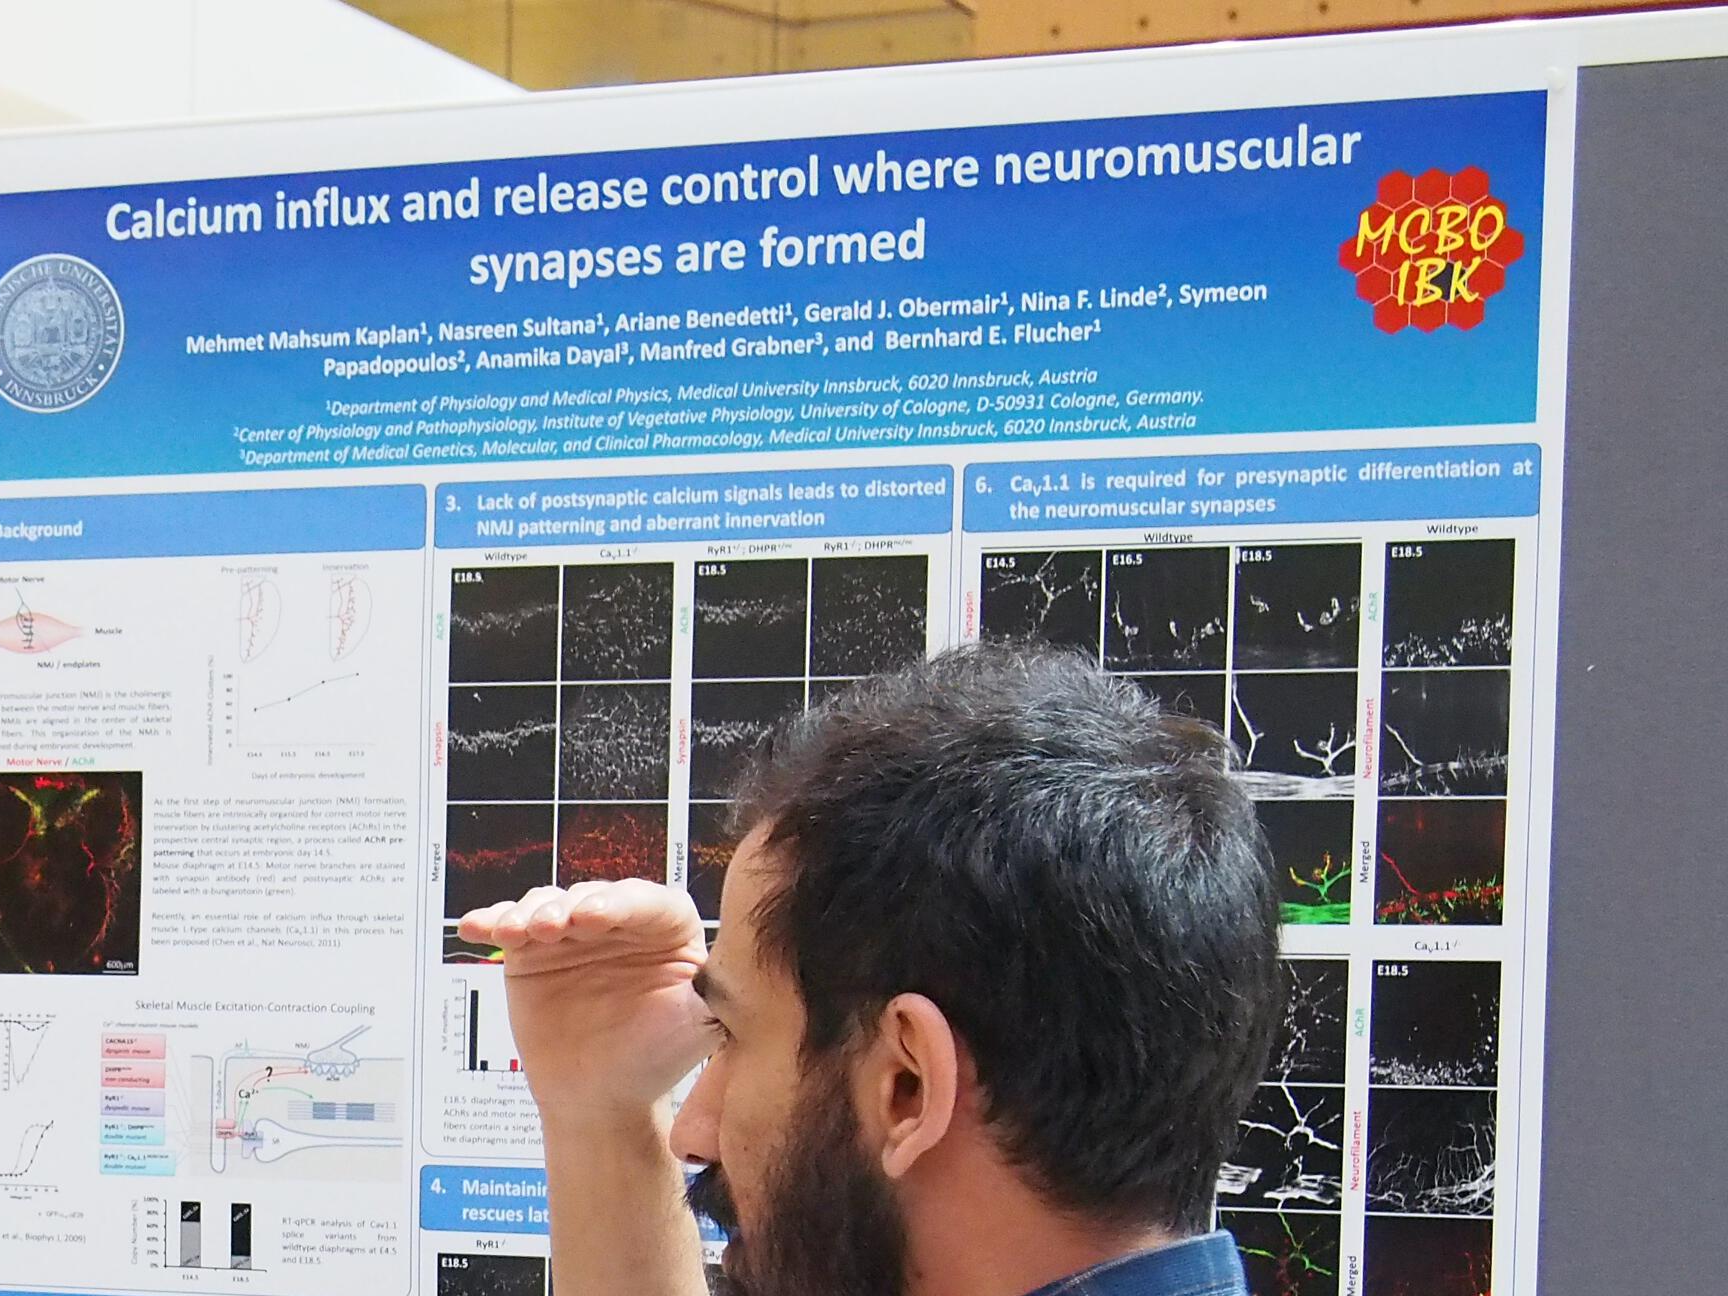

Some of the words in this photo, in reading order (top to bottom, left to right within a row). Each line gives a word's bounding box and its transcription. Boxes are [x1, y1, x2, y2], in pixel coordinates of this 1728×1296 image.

[107, 197, 261, 240] Calcium
[276, 187, 390, 229] influx
[403, 177, 479, 222] and
[495, 173, 647, 215] release
[662, 154, 818, 205] control
[833, 150, 979, 194] where
[996, 123, 1361, 185] neuromuscular
[1356, 205, 1505, 257] MCBO
[471, 245, 662, 292] synapses
[676, 240, 745, 273] are
[760, 218, 925, 267] formed
[1398, 257, 1481, 308] IBK
[187, 334, 264, 353] Mehmet
[269, 330, 350, 349] Mahsum
[439, 323, 517, 341] Nasreen
[615, 312, 680, 332] Ariane
[805, 300, 872, 322] Gerald
[878, 300, 892, 319] J.
[1022, 292, 1070, 311] Nina
[1078, 290, 1092, 309] F.
[1180, 285, 1267, 307] Symeon
[476, 347, 560, 368] Anamika
[641, 338, 725, 361] Manfred
[835, 331, 873, 352] and
[886, 326, 982, 349] Bernhard
[989, 326, 1006, 344] E.
[4, 373, 99, 406] INNSBRUCK
[421, 396, 437, 414] of
[440, 394, 517, 413] Physiology
[520, 392, 549, 407] and
[552, 389, 612, 406] Medical
[616, 387, 672, 405] Physics,
[678, 383, 738, 400] Medical
[742, 380, 819, 397] University
[824, 376, 902, 393] Innsbruck,
[909, 374, 949, 390] 6020
[953, 370, 1033, 388] Innsbruck,
[1039, 368, 1097, 384] Austria
[976, 476, 992, 493] 6.
[1081, 473, 1095, 489] is
[1107, 469, 1186, 492] required
[1197, 469, 1225, 486] for
[1236, 465, 1346, 488] presynaptic
[1359, 460, 1500, 480] differentiation
[1513, 459, 1532, 475] at
[446, 495, 460, 512] 3.
[478, 494, 513, 510] Lack
[519, 492, 536, 509] of
[542, 489, 647, 511] postsynaptic
[653, 487, 718, 504] calcium
[725, 484, 782, 505] signals
[789, 482, 834, 499] leads
[840, 483, 859, 497] to
[865, 478, 945, 497] distorted
[1010, 502, 1040, 519] the
[1046, 497, 1185, 518] neuromuscular
[1191, 499, 1276, 517] synapses
[477, 520, 513, 535] NMJ
[518, 517, 605, 538] patterning
[610, 515, 641, 532] and
[647, 514, 720, 530] aberrant
[726, 510, 825, 528] innervation
[1426, 523, 1479, 535] Wildtype
[484, 552, 528, 563] Wildtype
[986, 557, 1015, 568] E14.5
[1113, 554, 1142, 565] E16.5
[1242, 550, 1272, 561] E18.5
[1392, 546, 1422, 557] E18.5
[676, 718, 686, 765] Synapsin
[1363, 699, 1375, 779] Neurofilament
[1360, 841, 1370, 884] Merged
[1378, 965, 1408, 976] E18.5
[136, 1000, 173, 1010] Skeletal
[176, 1001, 212, 1011] Muscle
[216, 1002, 327, 1013] Excitation-Contraction
[331, 1004, 375, 1016] Coupling
[431, 1178, 446, 1193] 4.
[463, 1180, 547, 1196] Maintaini
[463, 1208, 523, 1222] rescues
[529, 1206, 548, 1223] lat
